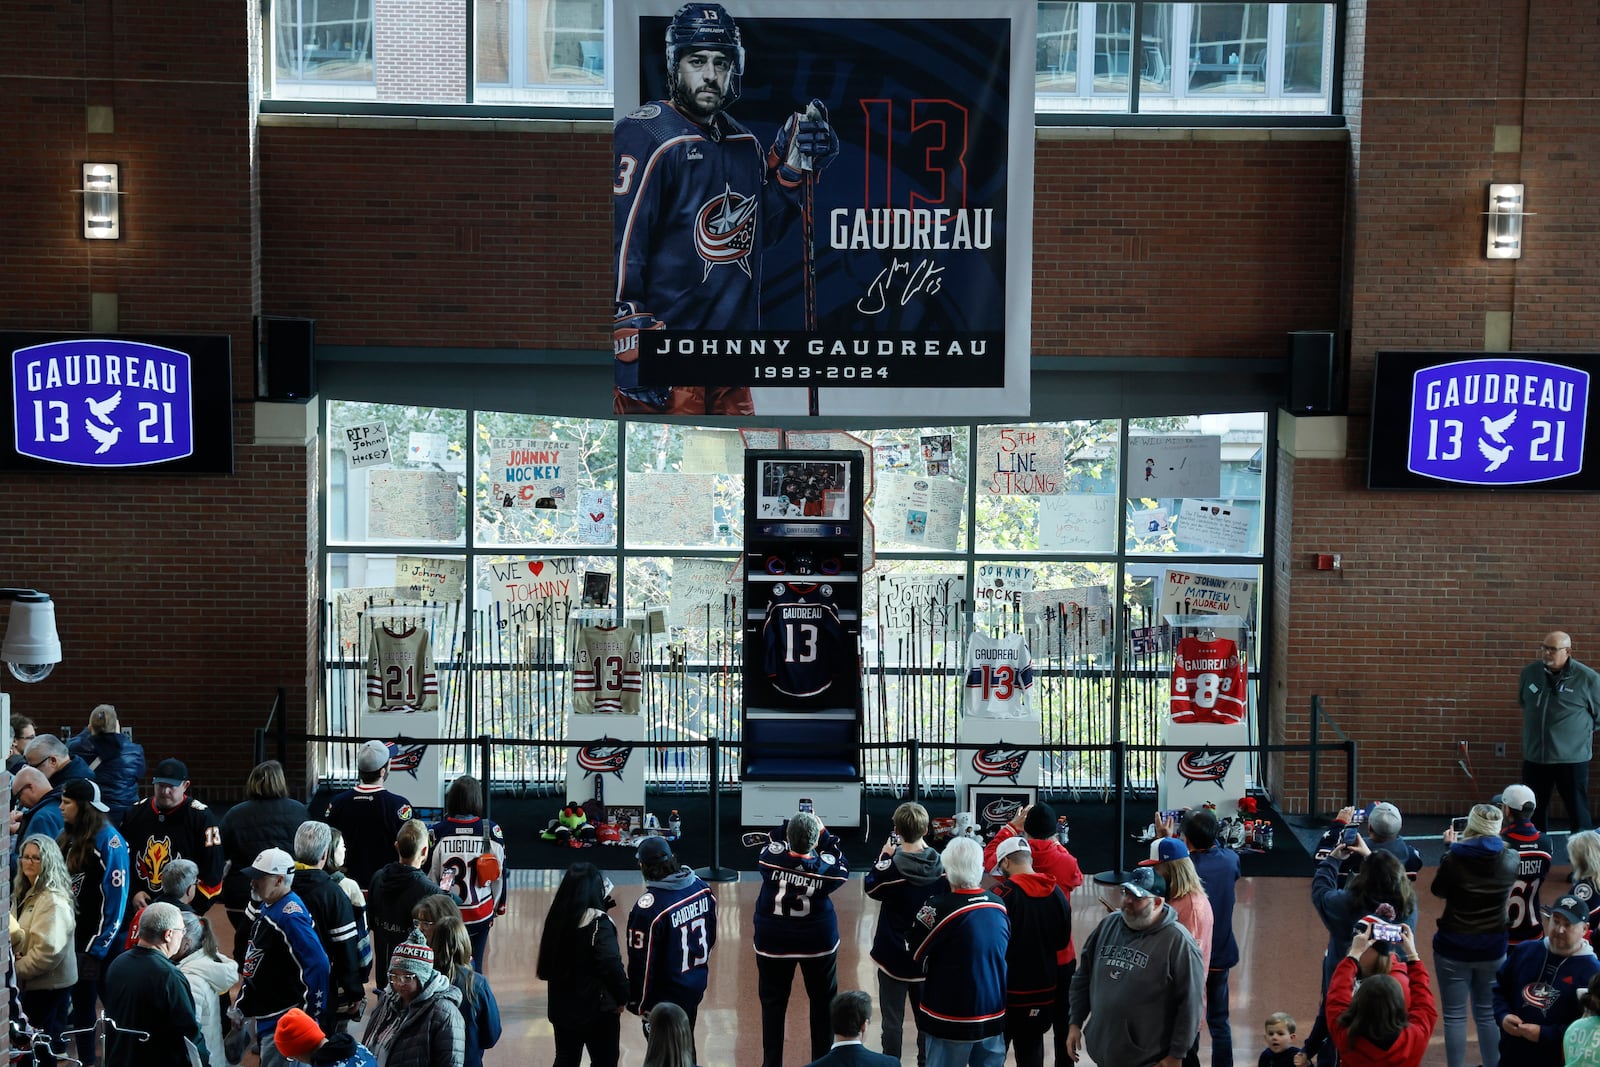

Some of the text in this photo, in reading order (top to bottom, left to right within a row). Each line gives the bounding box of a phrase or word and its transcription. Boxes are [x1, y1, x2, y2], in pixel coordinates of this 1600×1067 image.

[703, 9, 718, 20] 13
[859, 98, 969, 224] 13
[830, 207, 995, 251] GAUDREAU
[656, 338, 989, 357] JOHNNY GAUDREAU
[26, 354, 177, 395] GAUDREAU
[753, 365, 891, 380] 1993-2024
[1425, 373, 1575, 413] GAUDREAU
[33, 399, 71, 443] 13
[138, 401, 175, 444] 21
[346, 426, 370, 442] RIP
[352, 436, 386, 451] Johnny
[492, 438, 523, 449] REST
[543, 441, 571, 450] PEACE
[1000, 429, 1037, 453] 5TH
[1426, 418, 1464, 461] 13
[1529, 419, 1567, 462] 21
[352, 448, 390, 465] Hockey
[506, 449, 560, 467] JOHNNY
[996, 452, 1037, 473] LINE
[506, 466, 560, 482] HOCKEY
[988, 471, 1057, 495] STRONG
[411, 566, 447, 584] Johnny
[492, 557, 577, 582] WE YOU
[979, 565, 1031, 580] JOHNNY
[409, 583, 436, 598] Matty
[506, 579, 570, 603] JOHNNY
[1170, 572, 1191, 586] RIP
[1194, 576, 1229, 590] JOHNNY
[887, 576, 956, 609] JOHNNY
[1184, 586, 1231, 602] MATTHEW
[511, 599, 573, 624] HOCKEY
[783, 607, 823, 620] GAUDREAU
[785, 623, 819, 663] 13
[576, 650, 587, 664] 13
[628, 651, 640, 664] 13
[975, 648, 1019, 661] GAUDREAU
[1184, 659, 1230, 672] GAUDREAU
[386, 665, 416, 701] 21
[593, 656, 624, 691] 13
[980, 664, 1016, 701] 13
[1175, 676, 1187, 693] 8
[1221, 676, 1233, 692] 8
[1195, 672, 1220, 709] 8
[204, 826, 222, 848] 13
[773, 879, 816, 917] 13
[1506, 877, 1541, 930] 61
[670, 897, 709, 928] GAUDREAU
[628, 928, 645, 949] 13
[680, 918, 709, 973] 13
